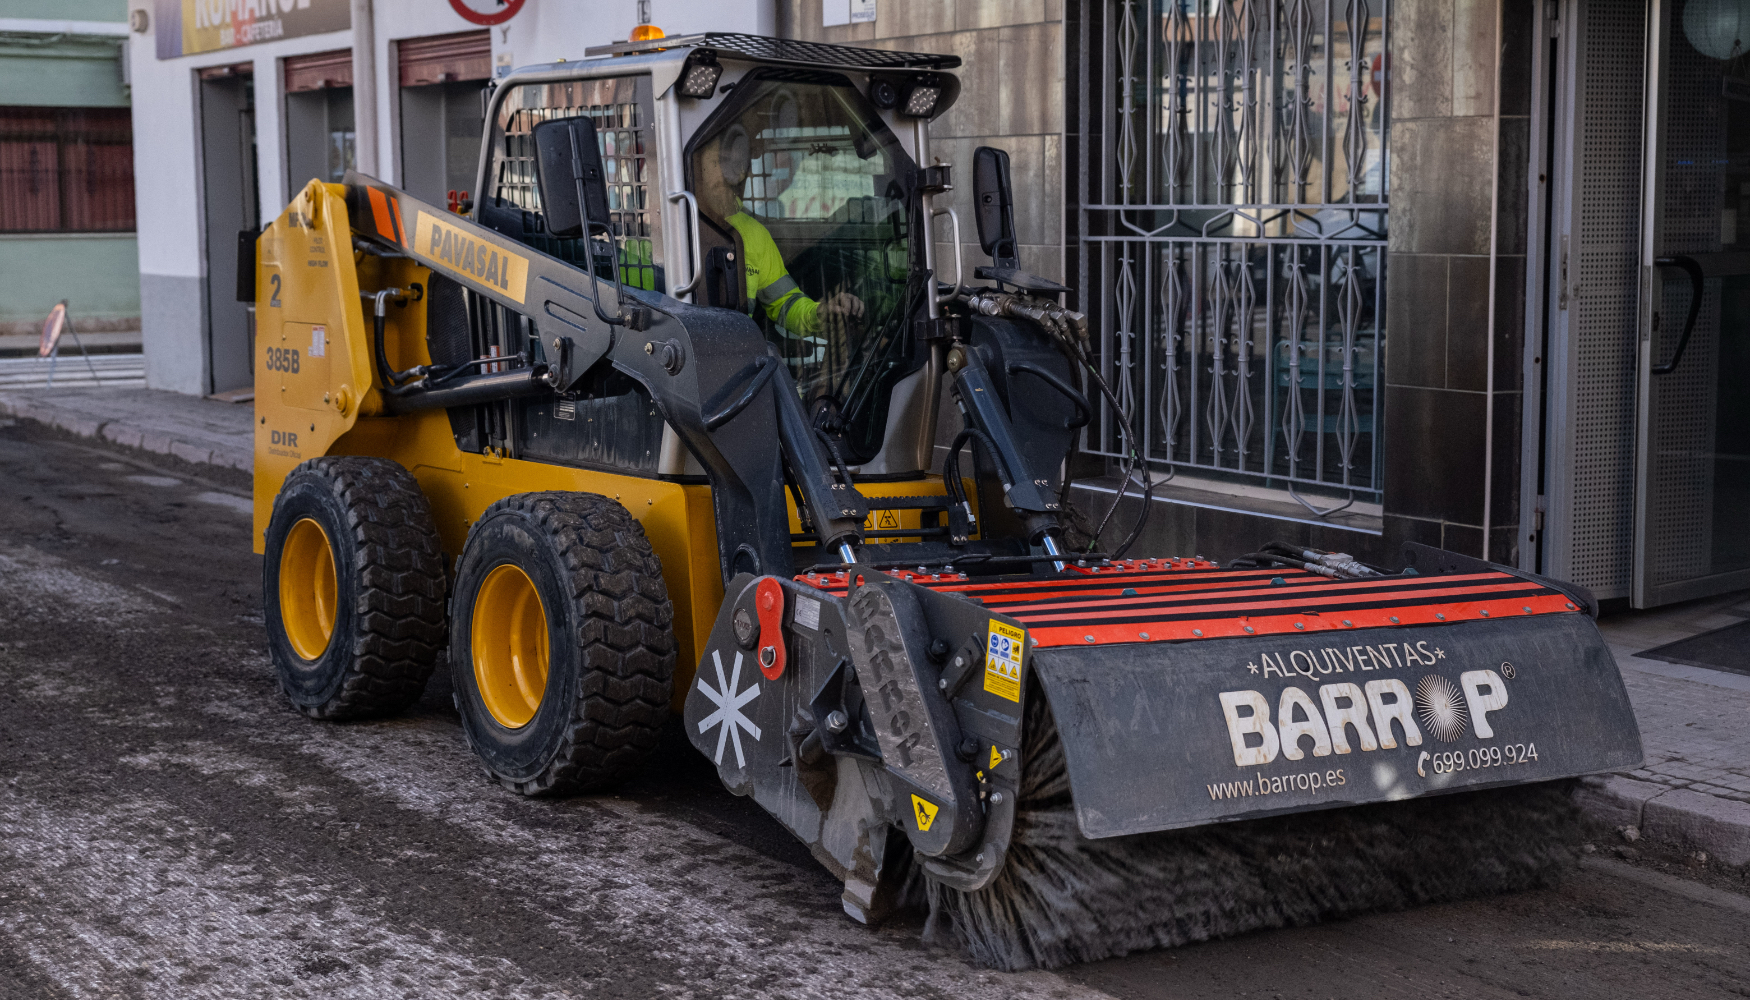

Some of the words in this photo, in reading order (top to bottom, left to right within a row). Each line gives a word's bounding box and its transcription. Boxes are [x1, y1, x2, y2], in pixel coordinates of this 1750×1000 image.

[429, 223, 509, 291] PAVASAL
[269, 273, 282, 308] 2
[266, 346, 300, 374] 385B
[271, 430, 298, 448] DIR
[998, 626, 1022, 640] PELIGRO
[1432, 742, 1539, 774] 699.099.924
[1207, 768, 1346, 801] www.barrop.es
